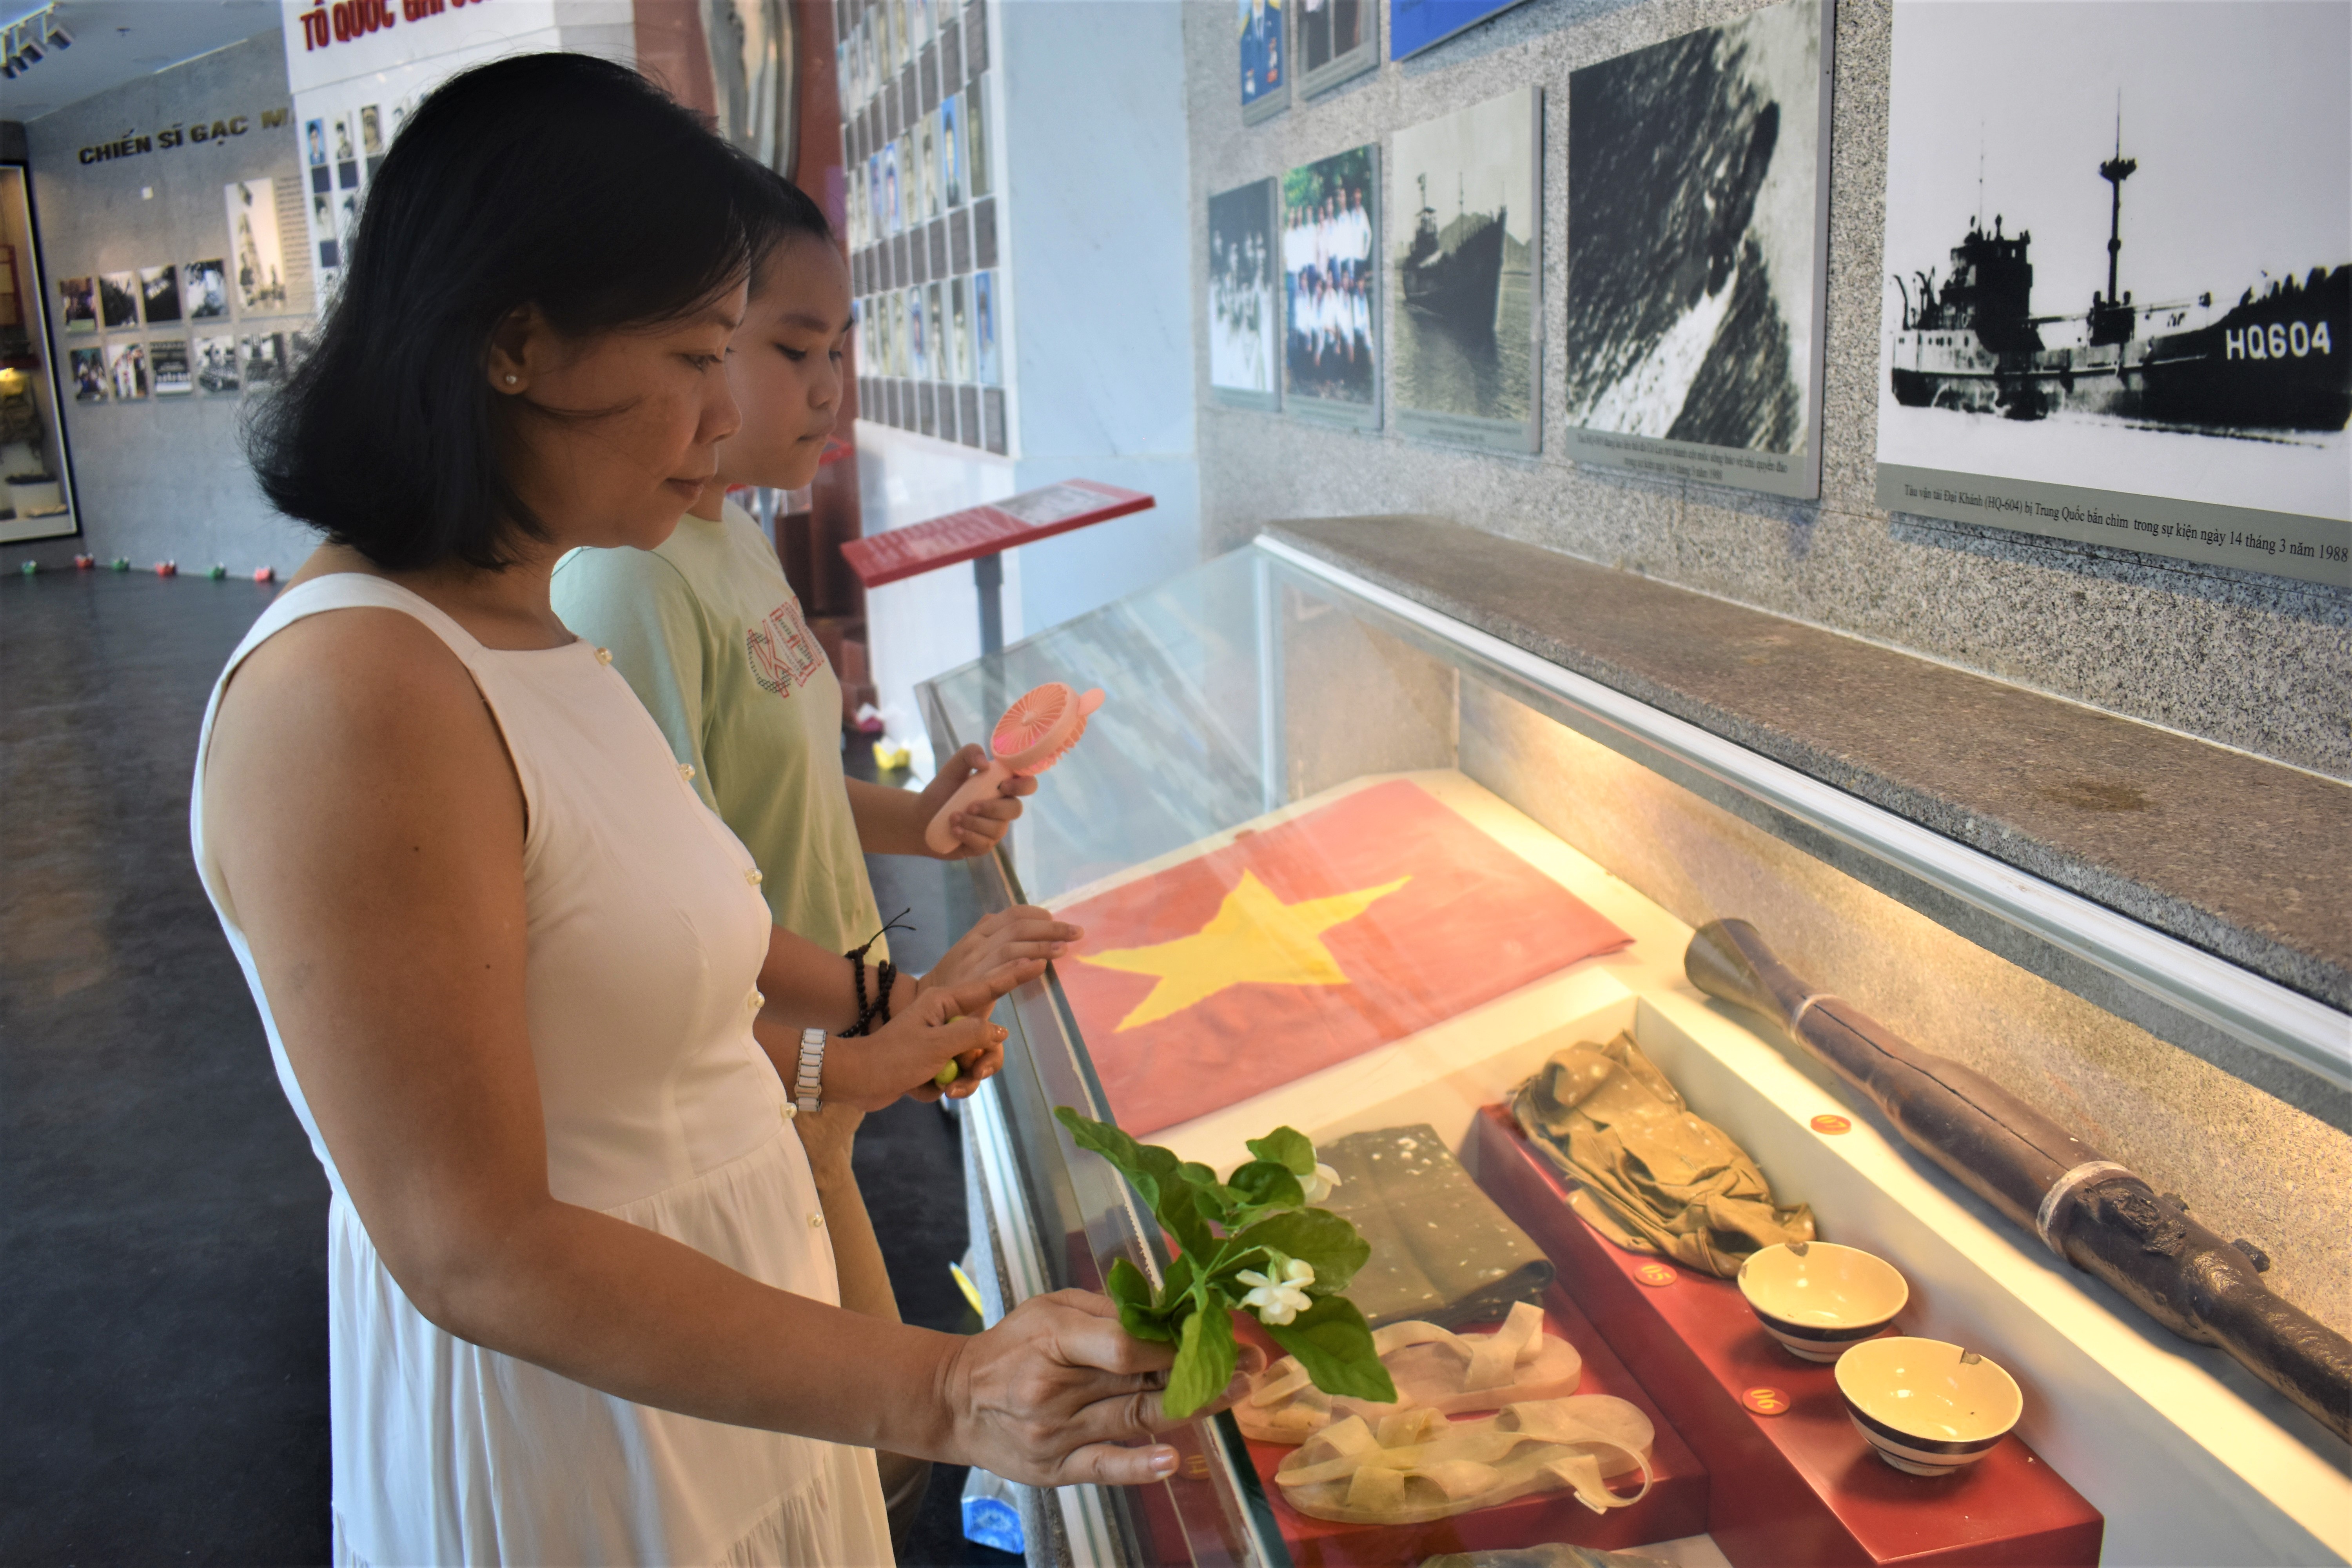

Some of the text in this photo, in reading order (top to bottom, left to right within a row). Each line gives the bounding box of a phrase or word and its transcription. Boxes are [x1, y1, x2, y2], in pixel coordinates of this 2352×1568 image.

[79, 107, 295, 165] CHIẾN SĨ GẠC M
[2226, 320, 2331, 360] HQ604
[1959, 492, 1982, 506] Khánh
[1985, 495, 2023, 514] (HQ-604)
[2025, 501, 2033, 516] bị
[2035, 503, 2059, 521] Trung
[2062, 505, 2085, 523] Quốc
[2087, 507, 2103, 524] bắn
[2106, 513, 2128, 528] chìm
[2134, 519, 2159, 536] trong
[2161, 524, 2174, 539] sự
[2176, 523, 2197, 541] kiện
[2200, 528, 2226, 546] ngày
[2230, 531, 2242, 545] 14
[2245, 533, 2276, 555] tháng
[2279, 538, 2286, 552] 3
[2290, 542, 2314, 557] năm
[2319, 544, 2348, 563] 1988
[1817, 1116, 1847, 1128] 07
[1642, 1265, 1671, 1281] 05
[1751, 1389, 1784, 1409] 06
